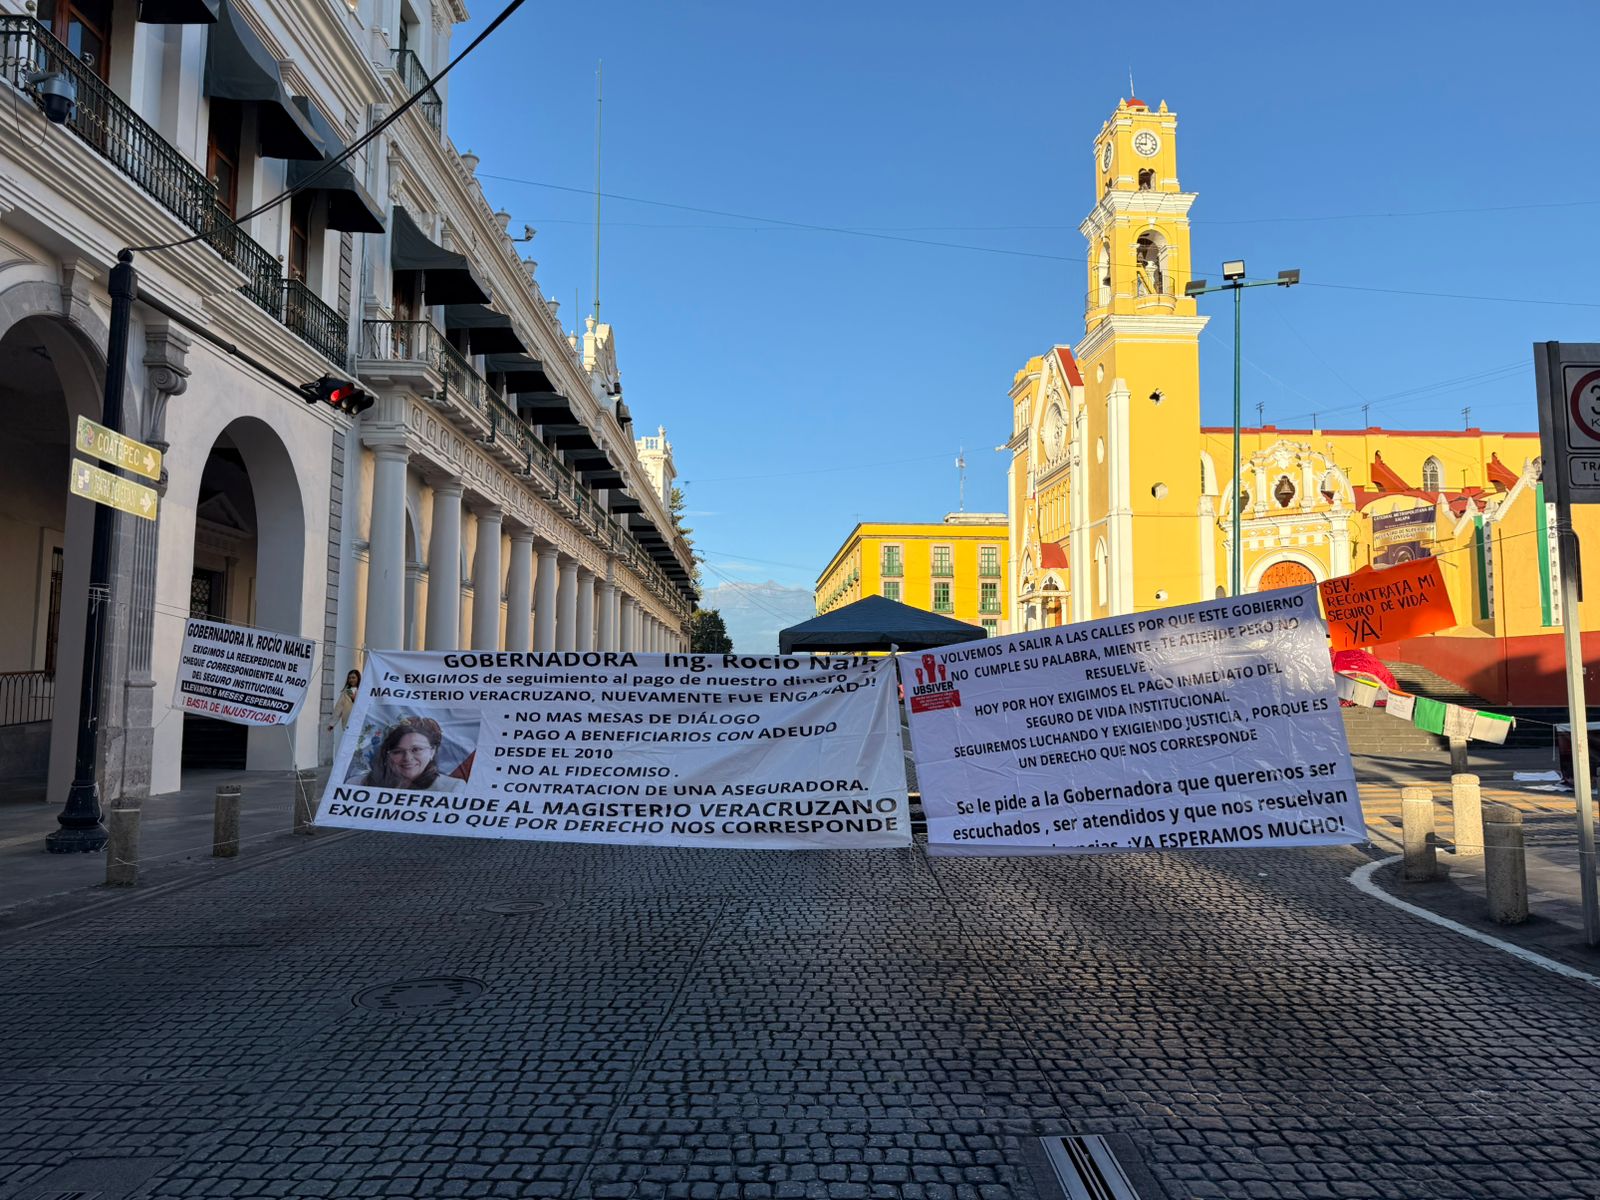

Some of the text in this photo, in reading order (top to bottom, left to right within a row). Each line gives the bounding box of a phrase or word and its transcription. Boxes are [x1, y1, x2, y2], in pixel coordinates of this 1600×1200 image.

[1323, 578, 1356, 596] SEV:
[1326, 574, 1436, 608] RECONTRATA MI
[1328, 592, 1429, 622] SEGURO DE VIDA
[187, 623, 245, 646] GOBERNADORA
[245, 633, 254, 649] N.
[283, 641, 312, 659] NAHLE
[940, 595, 1304, 664] VOLVEMOS A SALIR A LAS CALLES POR QUE ESTE GOBIERNO
[192, 644, 298, 673] EXIGIMOS LA REEXPEDICION DE
[443, 652, 638, 669] GOBERNADORA
[664, 653, 713, 673] Ing.
[722, 654, 800, 670] Rocio
[951, 617, 1299, 682] NO CUMPLE SU PALABRA, MIENTE TE ATIENDE PERO NO
[182, 655, 307, 688] CHEQUE CORRESPONDIENTE AL PAGO
[191, 670, 285, 697] DEL SEGURO INSTITUCIONAL
[383, 672, 848, 687] le EXIGIMOS de seguimiento al pago de nuestro dinero
[1085, 660, 1146, 680] RESUELVE
[212, 687, 217, 695] 6
[217, 689, 244, 702] MESES
[370, 687, 464, 701] MAGISTERIO
[470, 690, 596, 704] VERACRUZANO,
[601, 690, 722, 704] NUEVAMENTE
[728, 692, 763, 703] FUE
[913, 681, 954, 696] UBSIVER
[974, 662, 1283, 716] HOY POR HOY EXIGIMOS EL PAGO INMEDIATO DEL
[209, 702, 220, 713] DE
[515, 711, 760, 725] NO MAS MESAS DE DIÁLOGO
[1026, 691, 1230, 729] SEGURO DE VIDA INSTITUCIONAL
[513, 721, 838, 742] PAGO A BENEFICIARIOS CON ADEUDO
[953, 698, 1329, 758] SEGUIREMOS LUCHANDO Y EXIGIENDO JUSTICIA PORQUE ES
[494, 746, 613, 759] DESDE EL 2010
[1018, 728, 1258, 769] UN DERECHO QUE NOS CORRESPONDE
[507, 764, 670, 777] NO AL FIDECOMISO
[503, 779, 869, 796] CONTRATACION DE UNA ASEGURADORA.
[956, 761, 1337, 815] Se le pide a la Gobernadora que queremos ser
[333, 787, 898, 818] NO DEFRAUDE AL MAGISTERIO VERACRUZANO
[953, 789, 1348, 840] escuchados ser atendidos y que nos resuelvan
[328, 804, 898, 834] EXIGIMOS LO QUE POR DERECHO NOS CORRESPONDE
[1159, 824, 1264, 848] ESPERAMOS
[1267, 816, 1346, 838] MUCHO!
